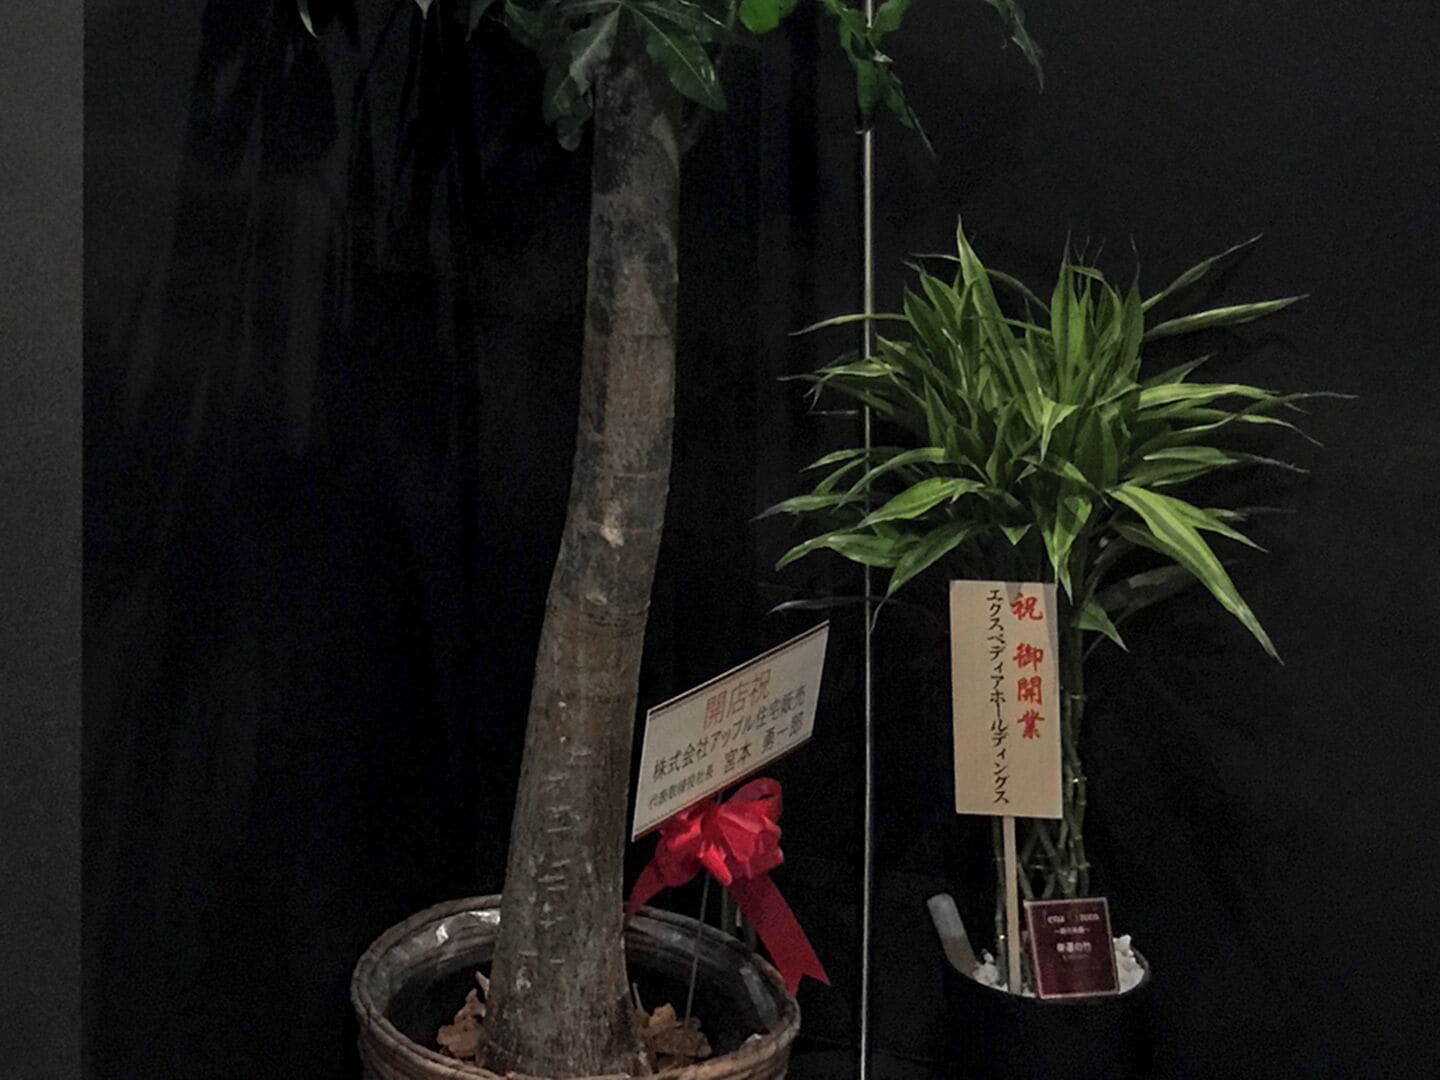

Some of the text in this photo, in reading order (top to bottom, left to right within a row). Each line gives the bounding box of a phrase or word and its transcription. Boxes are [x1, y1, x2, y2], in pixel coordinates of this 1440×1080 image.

[703, 669, 772, 731] 開店祝
[986, 589, 1010, 805] エクスペディアホールディングス
[1010, 592, 1045, 740] 祝 御開業
